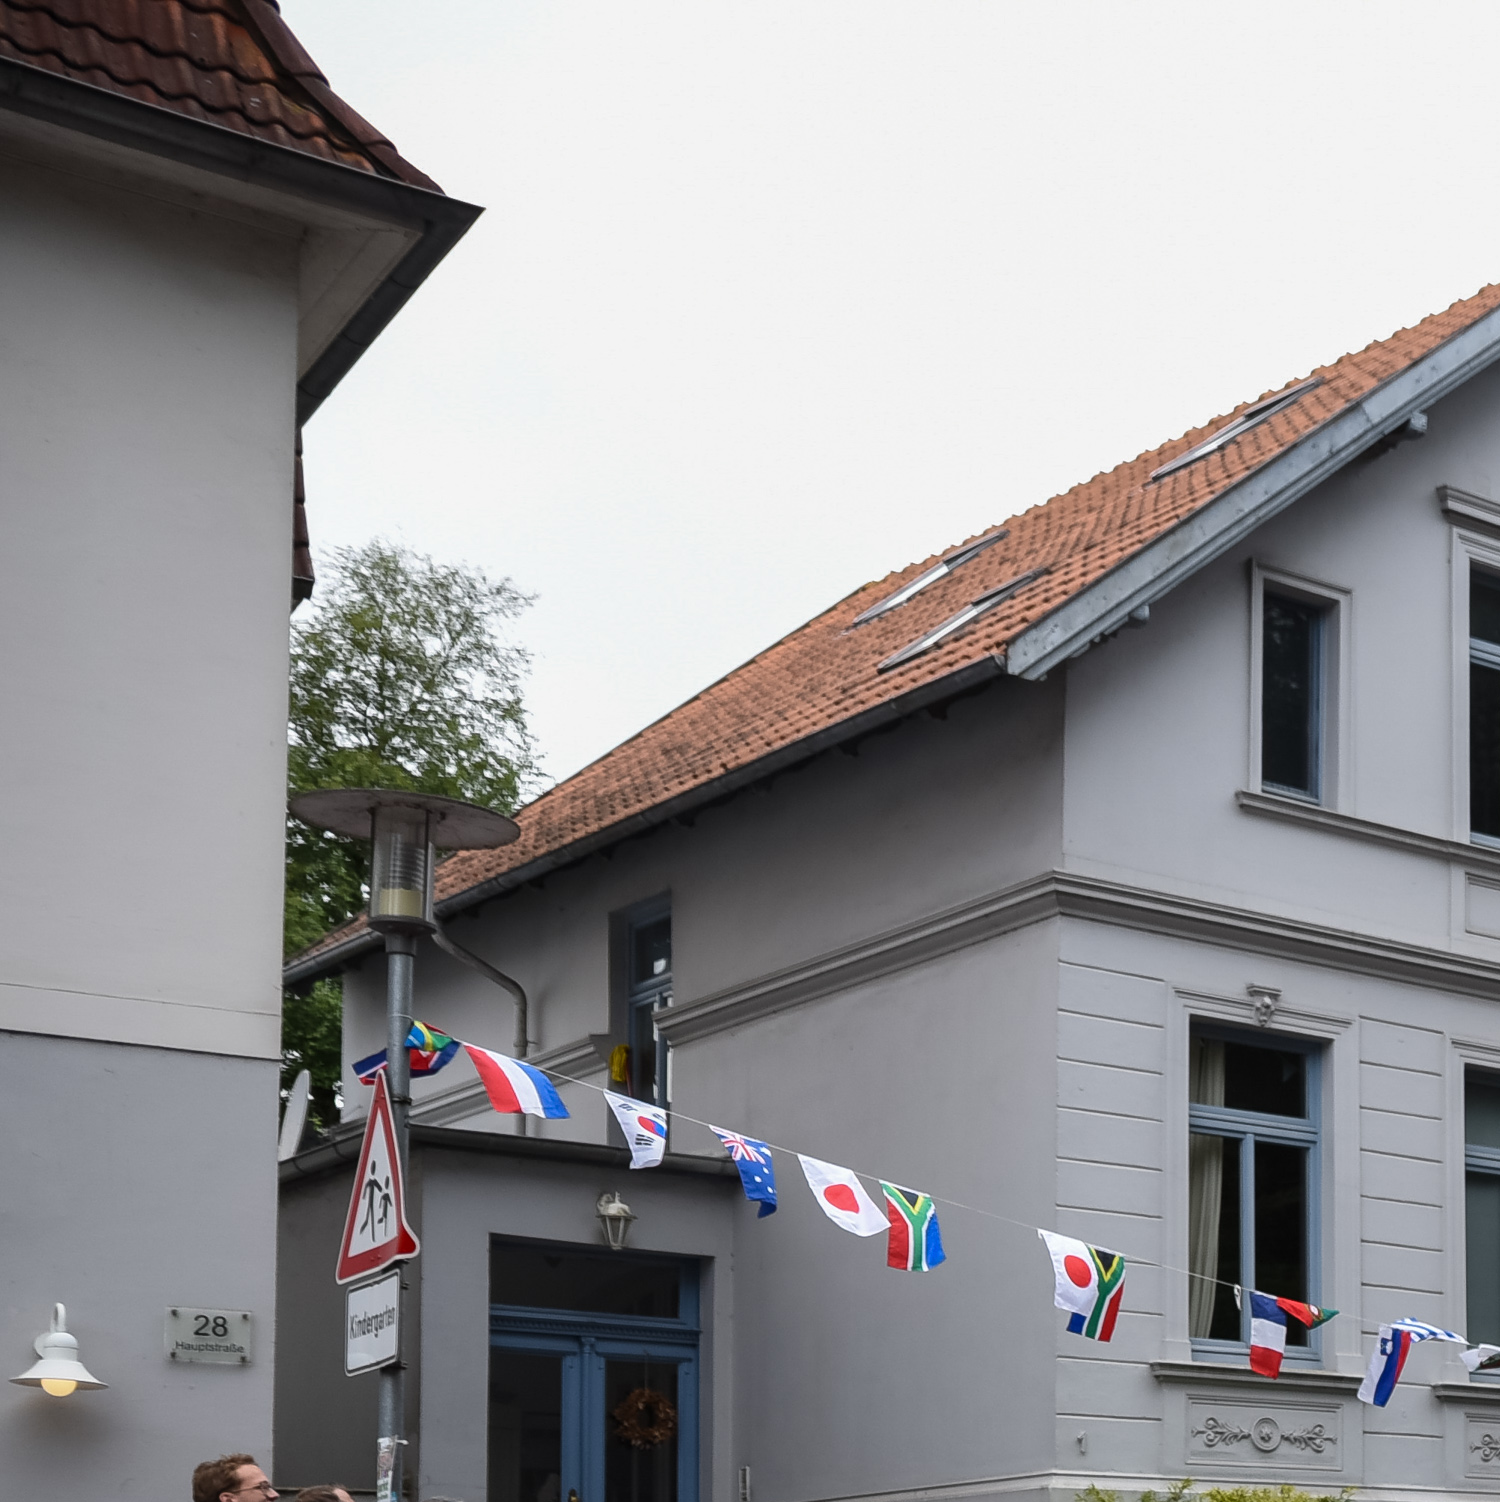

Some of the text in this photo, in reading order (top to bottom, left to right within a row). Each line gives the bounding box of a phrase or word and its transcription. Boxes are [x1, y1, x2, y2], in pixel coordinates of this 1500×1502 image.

[193, 1314, 229, 1337] 28
[350, 1304, 396, 1339] Kindergarten
[175, 1341, 245, 1353] Hauptstraße
